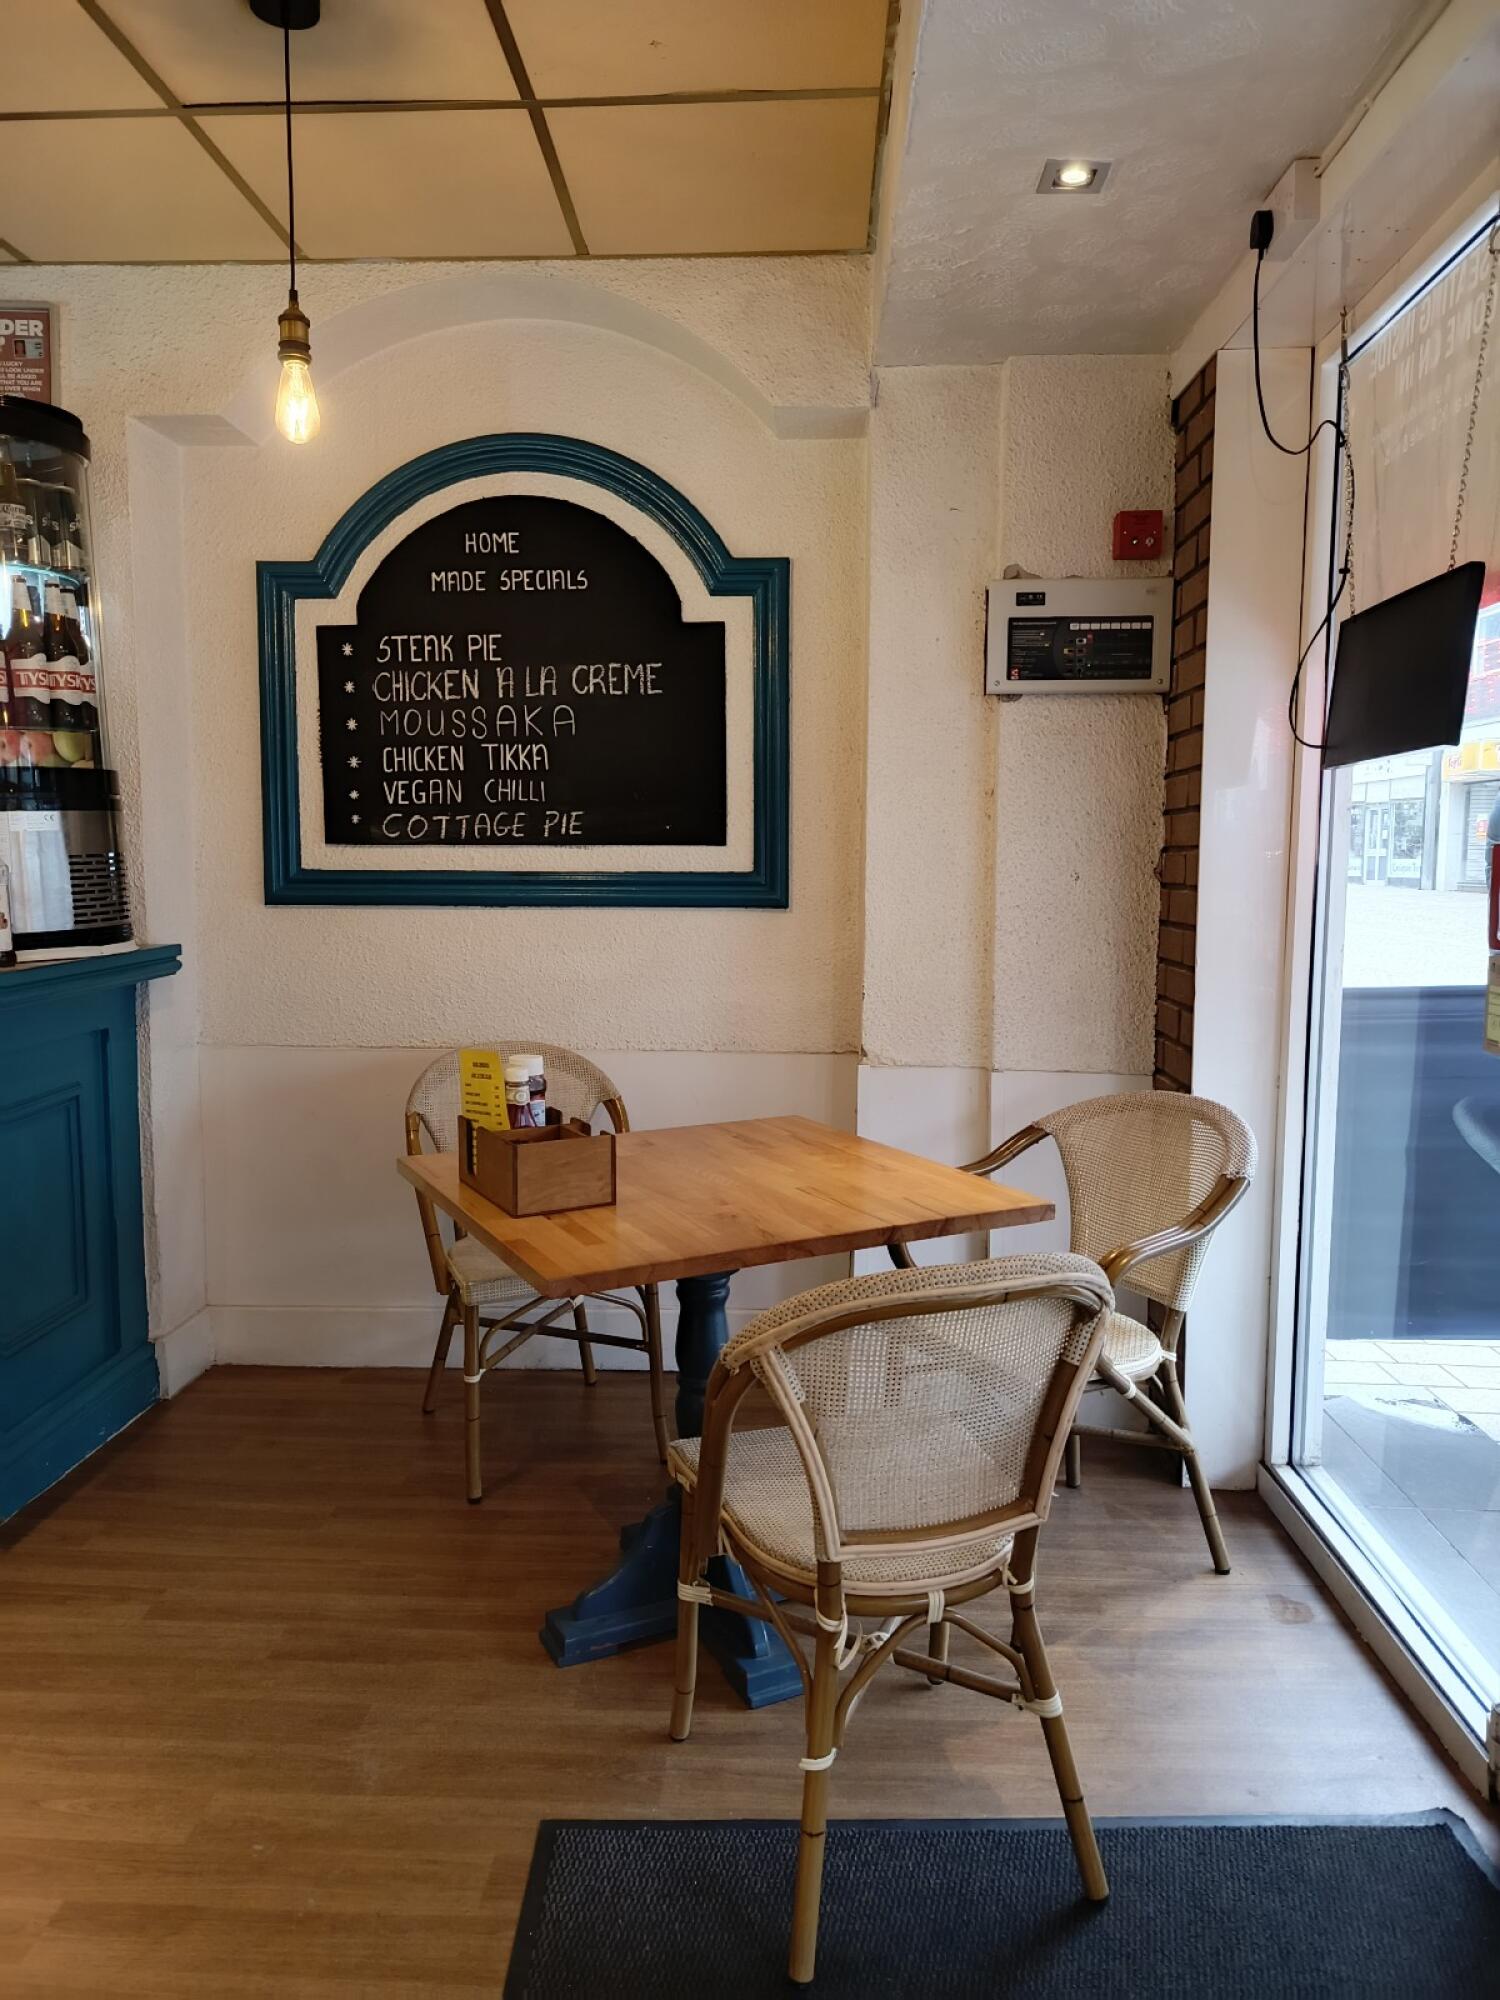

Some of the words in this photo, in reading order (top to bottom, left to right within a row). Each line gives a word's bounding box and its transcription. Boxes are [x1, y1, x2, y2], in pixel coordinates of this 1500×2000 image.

[465, 531, 520, 554] HOME
[430, 570, 486, 592] MADE
[499, 569, 588, 591] SPECIALS
[376, 634, 454, 663] STEAK
[467, 633, 502, 662] PIE
[372, 668, 480, 702] CHICKEN
[496, 666, 515, 699] A
[525, 665, 557, 697] LA
[571, 662, 663, 695] CREME
[380, 704, 576, 740] MOUSSAKA
[383, 745, 465, 773] CHICKEN
[480, 743, 549, 771] TIKKA
[383, 778, 462, 805] VEGAN
[484, 779, 546, 803] CHILLI
[382, 811, 527, 840] COTTAGE
[543, 810, 585, 837] PIE
